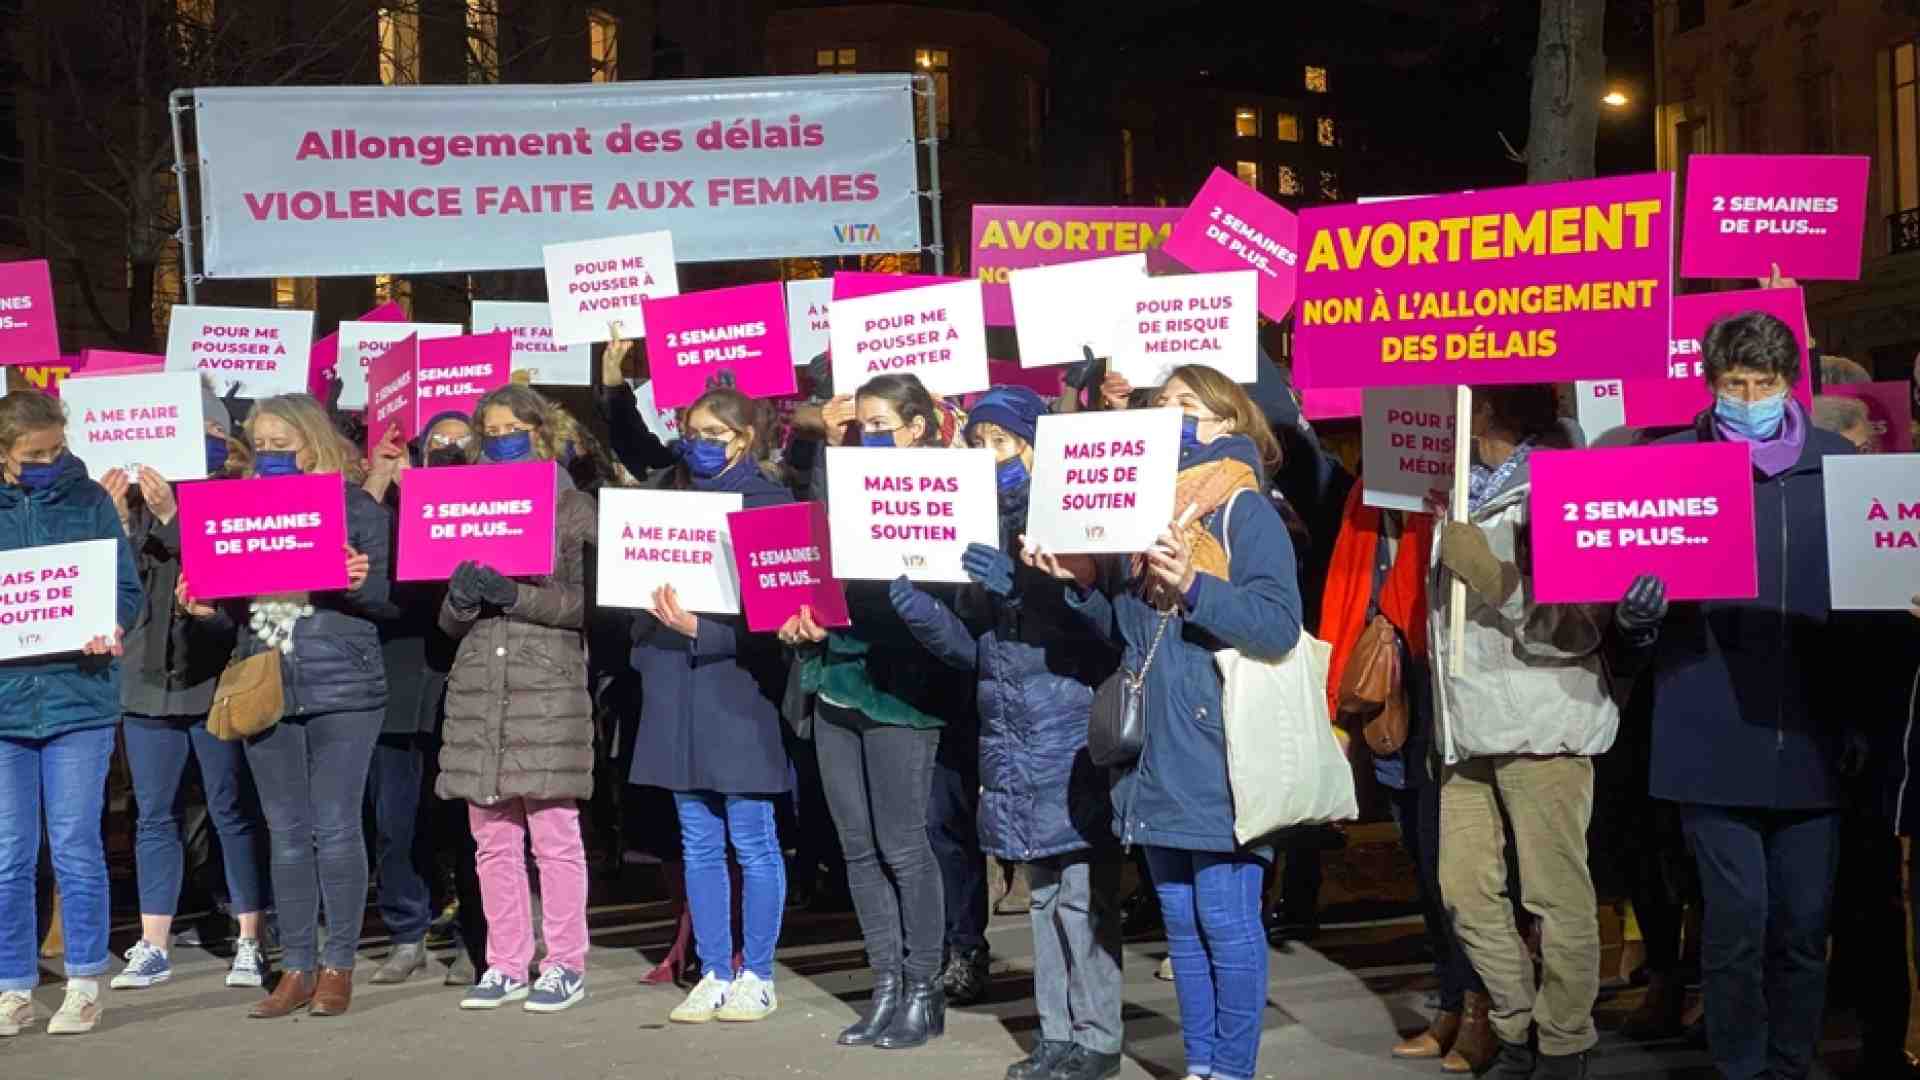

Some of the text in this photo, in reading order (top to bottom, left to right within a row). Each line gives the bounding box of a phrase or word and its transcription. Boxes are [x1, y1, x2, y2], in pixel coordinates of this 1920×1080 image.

[297, 115, 825, 166] Allongement des délais
[243, 173, 880, 222] VIOLENCE FAITE AUX FEMMES
[1712, 196, 1839, 213] 2 SEMAINES
[1206, 224, 1230, 246] DE
[1210, 206, 1298, 266] 2 SEMAINES
[1305, 199, 1662, 273] AVORTEMENT
[1720, 219, 1749, 234] DE
[575, 256, 645, 275] POUR ME
[569, 275, 639, 294] POUSSER
[1136, 295, 1233, 314] POUR PLUS
[1303, 279, 1659, 326] NON À L'ALLONGEMENT
[865, 308, 947, 332] POUR ME
[1138, 316, 1230, 335] DE RISQUE
[203, 325, 280, 339] POUR ME
[666, 321, 768, 348] 2 SEMAINES
[192, 341, 270, 354] POUSSER
[857, 330, 939, 354] POUSSER
[1145, 337, 1222, 353] MÉDICAL
[1380, 325, 1558, 363] DES DÉLAIS
[198, 357, 277, 371] AVORTER
[677, 351, 701, 367] DE
[867, 349, 951, 373] AVORTER
[419, 363, 493, 381] SEMAINES
[1594, 384, 1619, 398] DE
[101, 408, 126, 422] ME
[130, 405, 178, 420] FAIRE
[1387, 409, 1441, 428] POUR
[89, 426, 177, 442] HARCELER
[1391, 433, 1417, 449] DE
[1064, 440, 1146, 460] MAIS PAS
[864, 476, 959, 493] MAIS PAS
[1066, 466, 1138, 485] PLUS DE
[422, 499, 533, 519] 2 SEMAINES
[871, 501, 954, 517] PLUS DE
[1062, 492, 1137, 511] SOUTIEN
[1563, 497, 1719, 521] 2 SEMAINES
[1867, 497, 1888, 520] À
[205, 512, 321, 535] 2 SEMAINES
[431, 523, 457, 540] DE
[638, 526, 663, 541] ME
[668, 527, 717, 543] FAIRE
[871, 525, 957, 542] SOUTIEN
[1576, 528, 1613, 549] DE
[215, 538, 244, 555] DE
[624, 546, 713, 565] HARCELER
[749, 546, 821, 567] 2 SEMAINES
[41, 565, 79, 581] PAS
[759, 573, 777, 588] DE
[46, 586, 73, 600] DE
